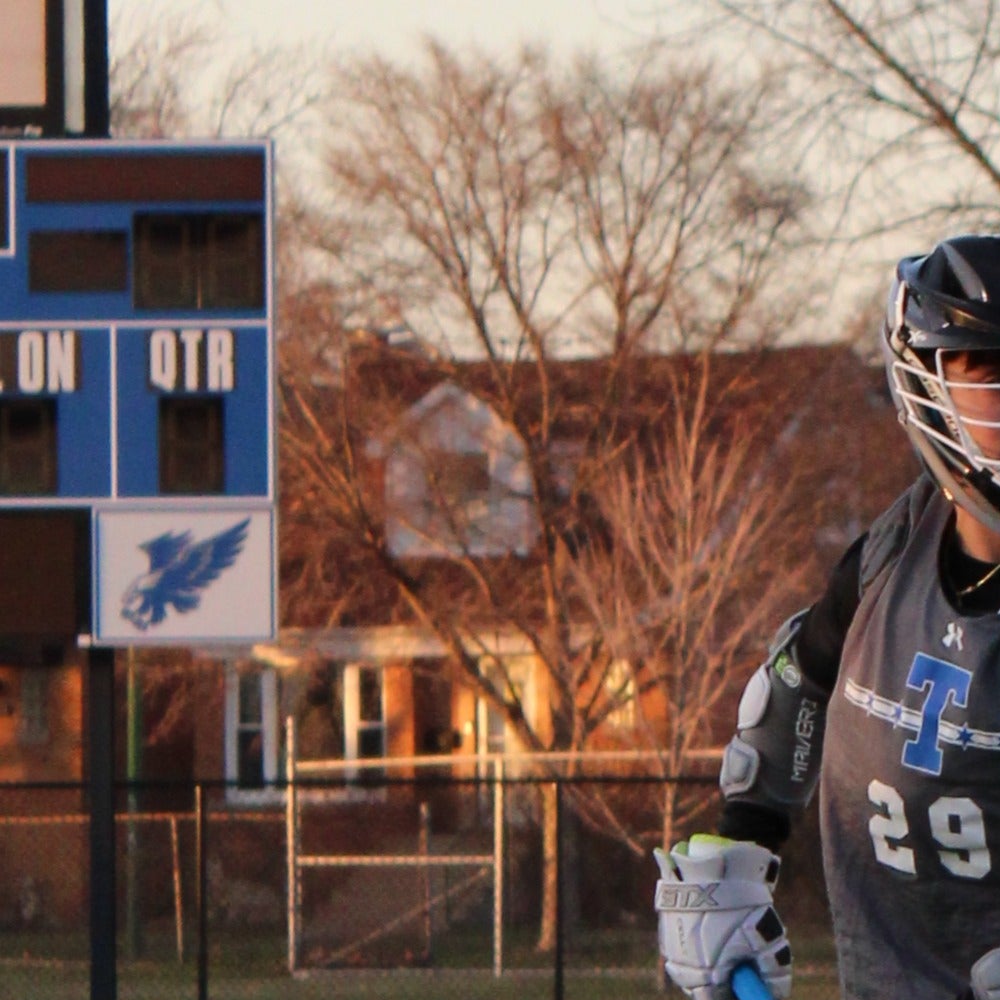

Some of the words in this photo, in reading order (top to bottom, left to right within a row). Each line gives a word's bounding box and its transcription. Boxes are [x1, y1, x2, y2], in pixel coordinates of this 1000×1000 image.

[18, 329, 76, 393] ON
[150, 329, 234, 392] QTR
[901, 651, 973, 776] T
[867, 779, 992, 880] 29
[660, 882, 720, 908] STX
